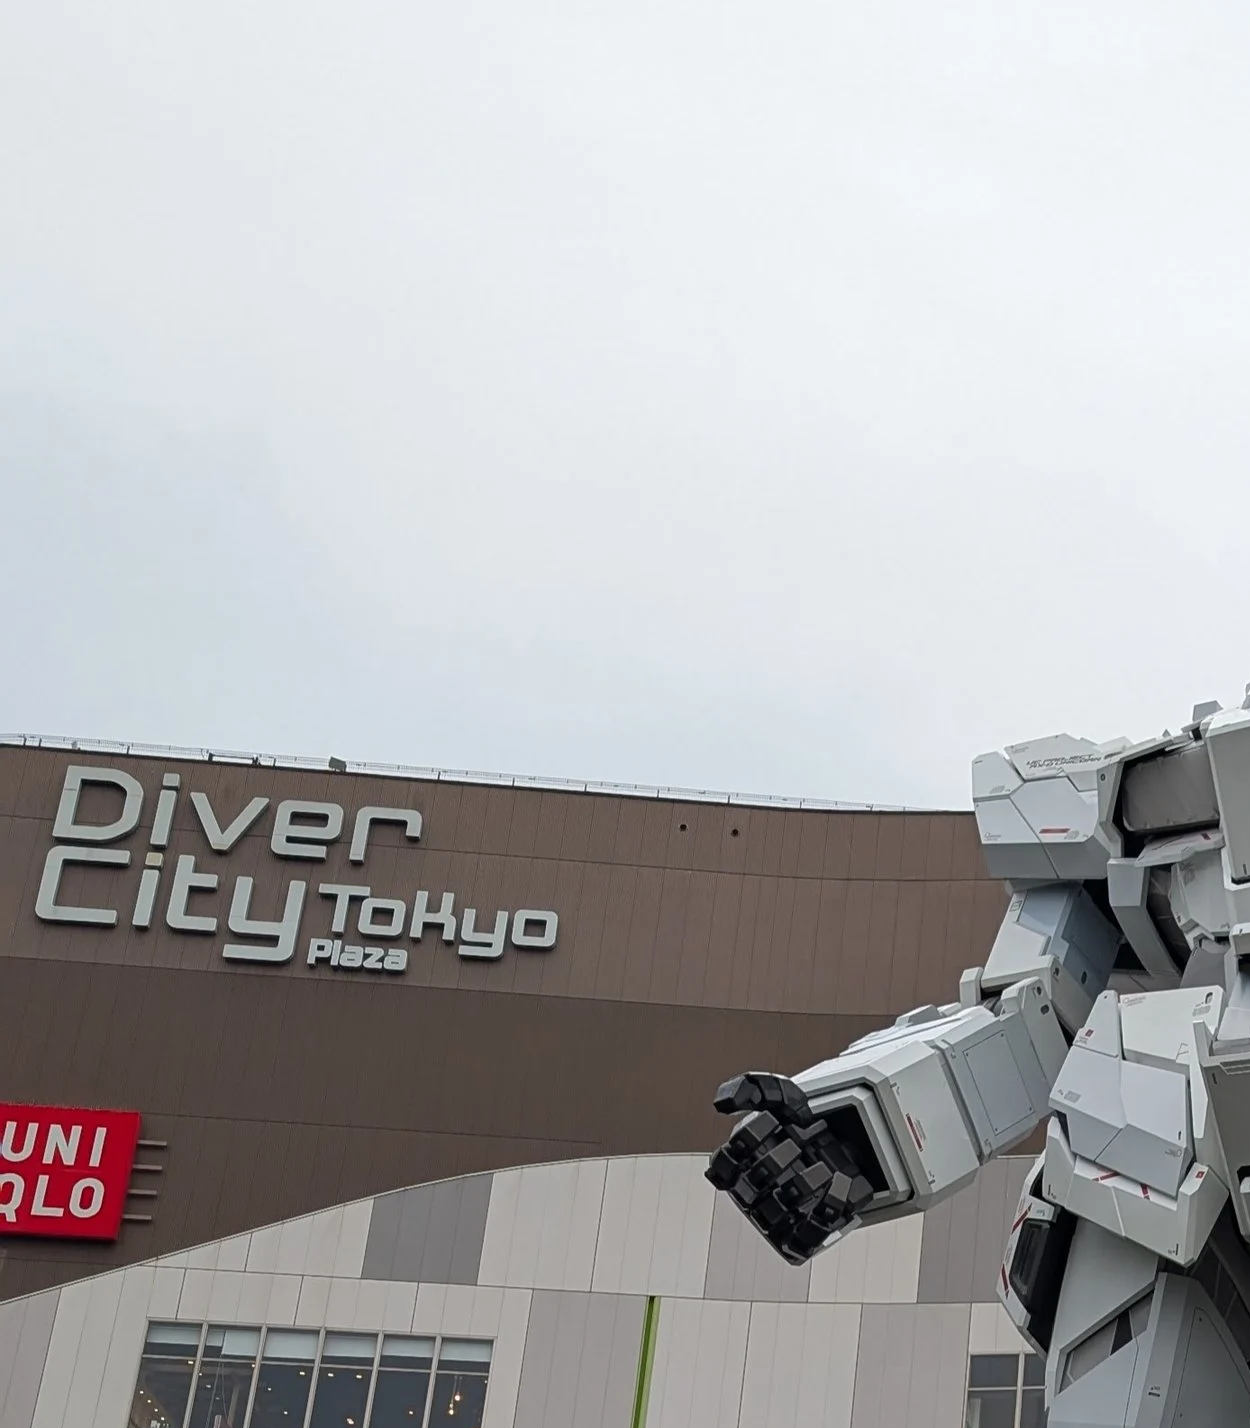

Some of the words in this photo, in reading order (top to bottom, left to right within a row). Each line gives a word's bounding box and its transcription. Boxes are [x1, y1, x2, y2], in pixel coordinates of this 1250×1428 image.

[52, 765, 422, 865] Diver
[35, 845, 306, 964] City
[307, 938, 408, 972] Plaza
[2, 1121, 107, 1167] UNI
[0, 1173, 105, 1222] QLO
